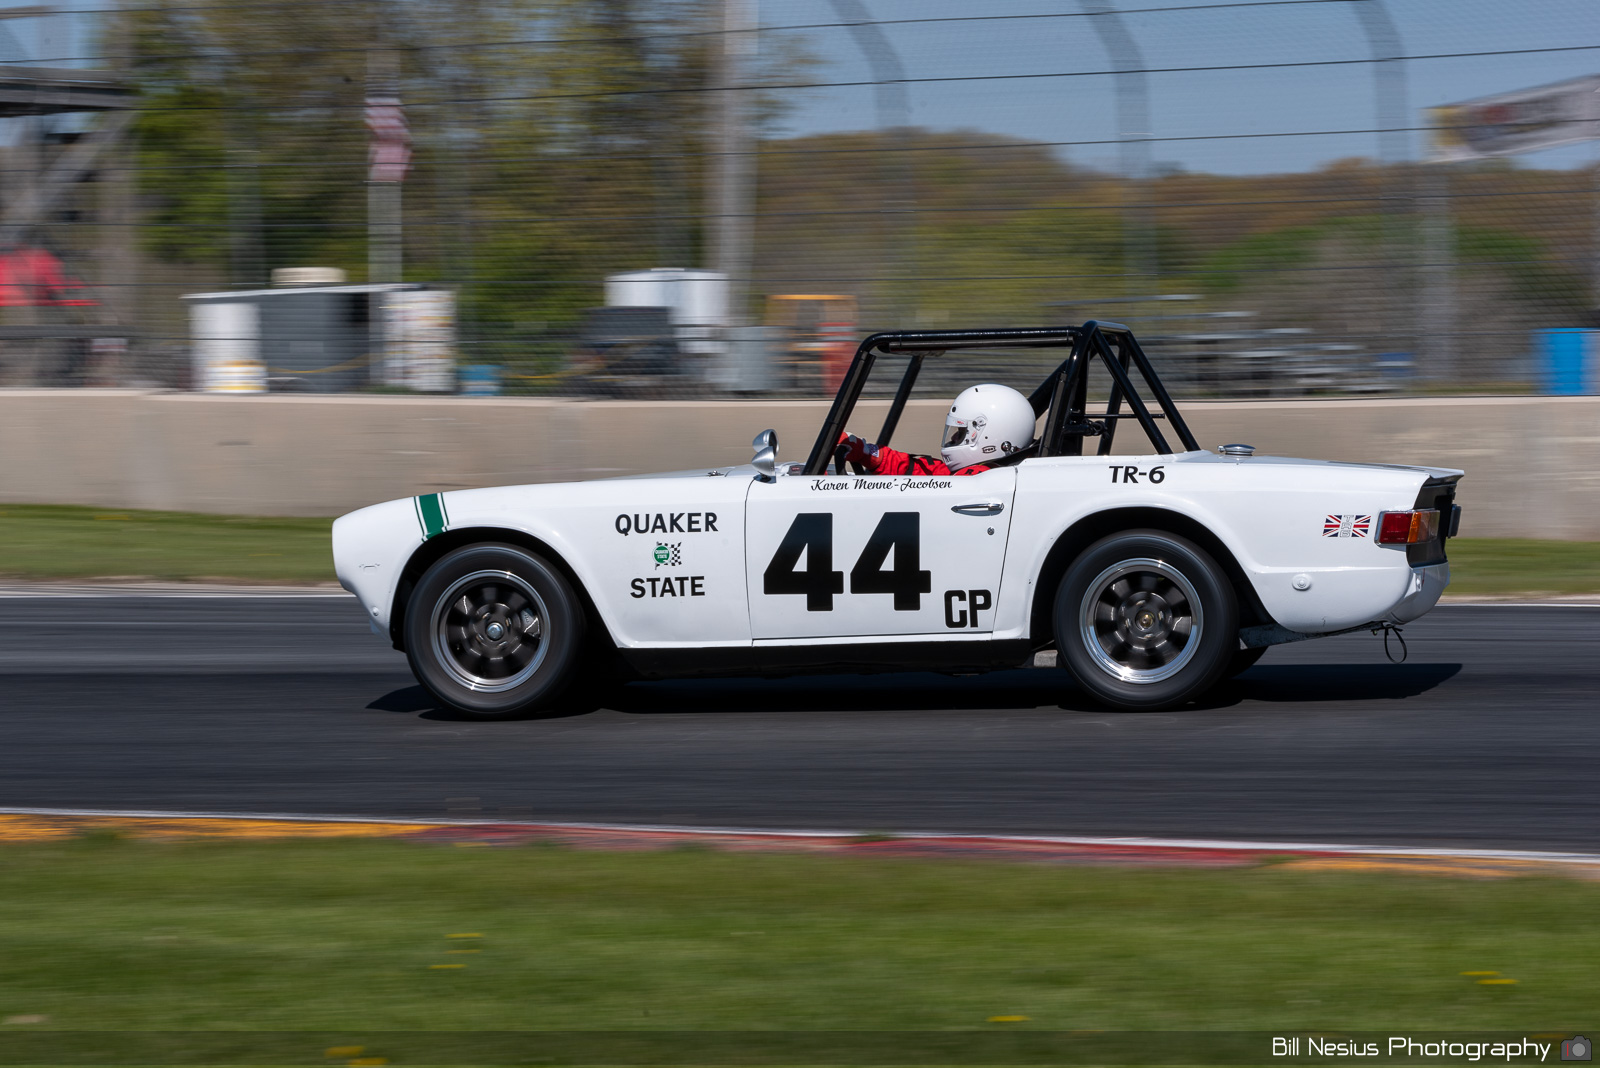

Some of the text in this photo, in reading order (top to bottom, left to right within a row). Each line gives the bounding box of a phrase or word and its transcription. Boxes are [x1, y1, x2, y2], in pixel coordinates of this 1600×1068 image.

[811, 479, 849, 491] Karen
[1109, 466, 1165, 485] TR-6
[615, 512, 718, 536] QUAKER
[763, 511, 932, 612] 44
[630, 576, 706, 599] STATE
[944, 589, 992, 629] CP
